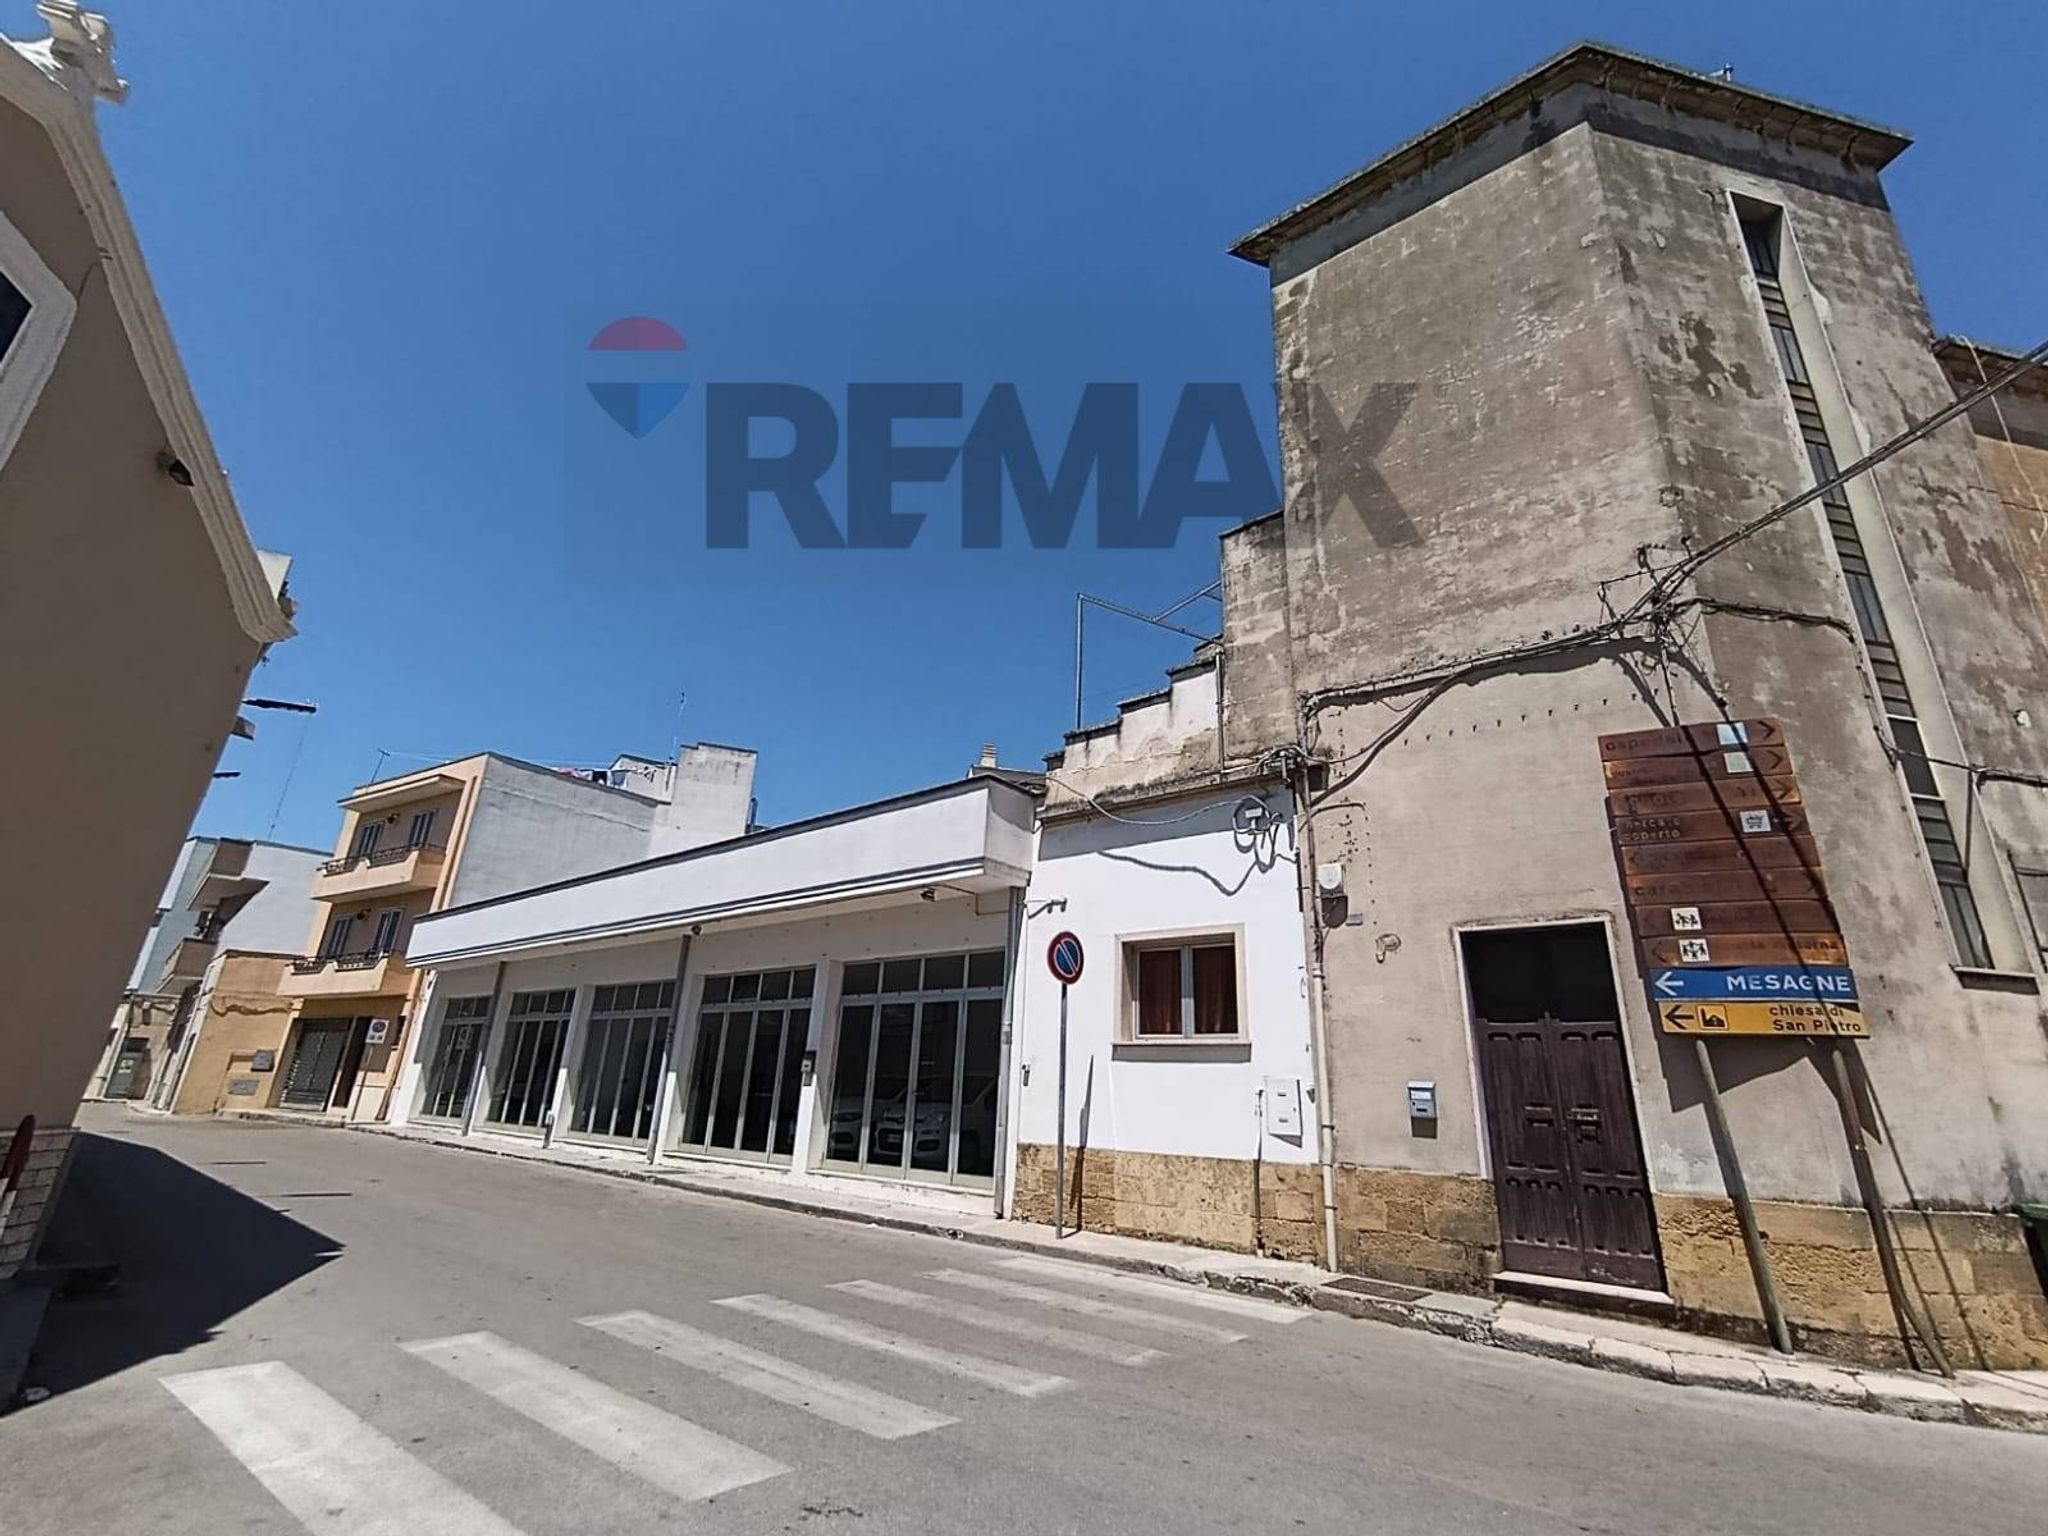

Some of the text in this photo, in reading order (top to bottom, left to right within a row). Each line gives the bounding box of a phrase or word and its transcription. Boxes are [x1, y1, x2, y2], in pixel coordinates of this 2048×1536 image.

[1726, 974, 1851, 991] MESAGNE
[1769, 1004, 1844, 1018] chiesa di
[1773, 1019, 1862, 1033] San Pietro
